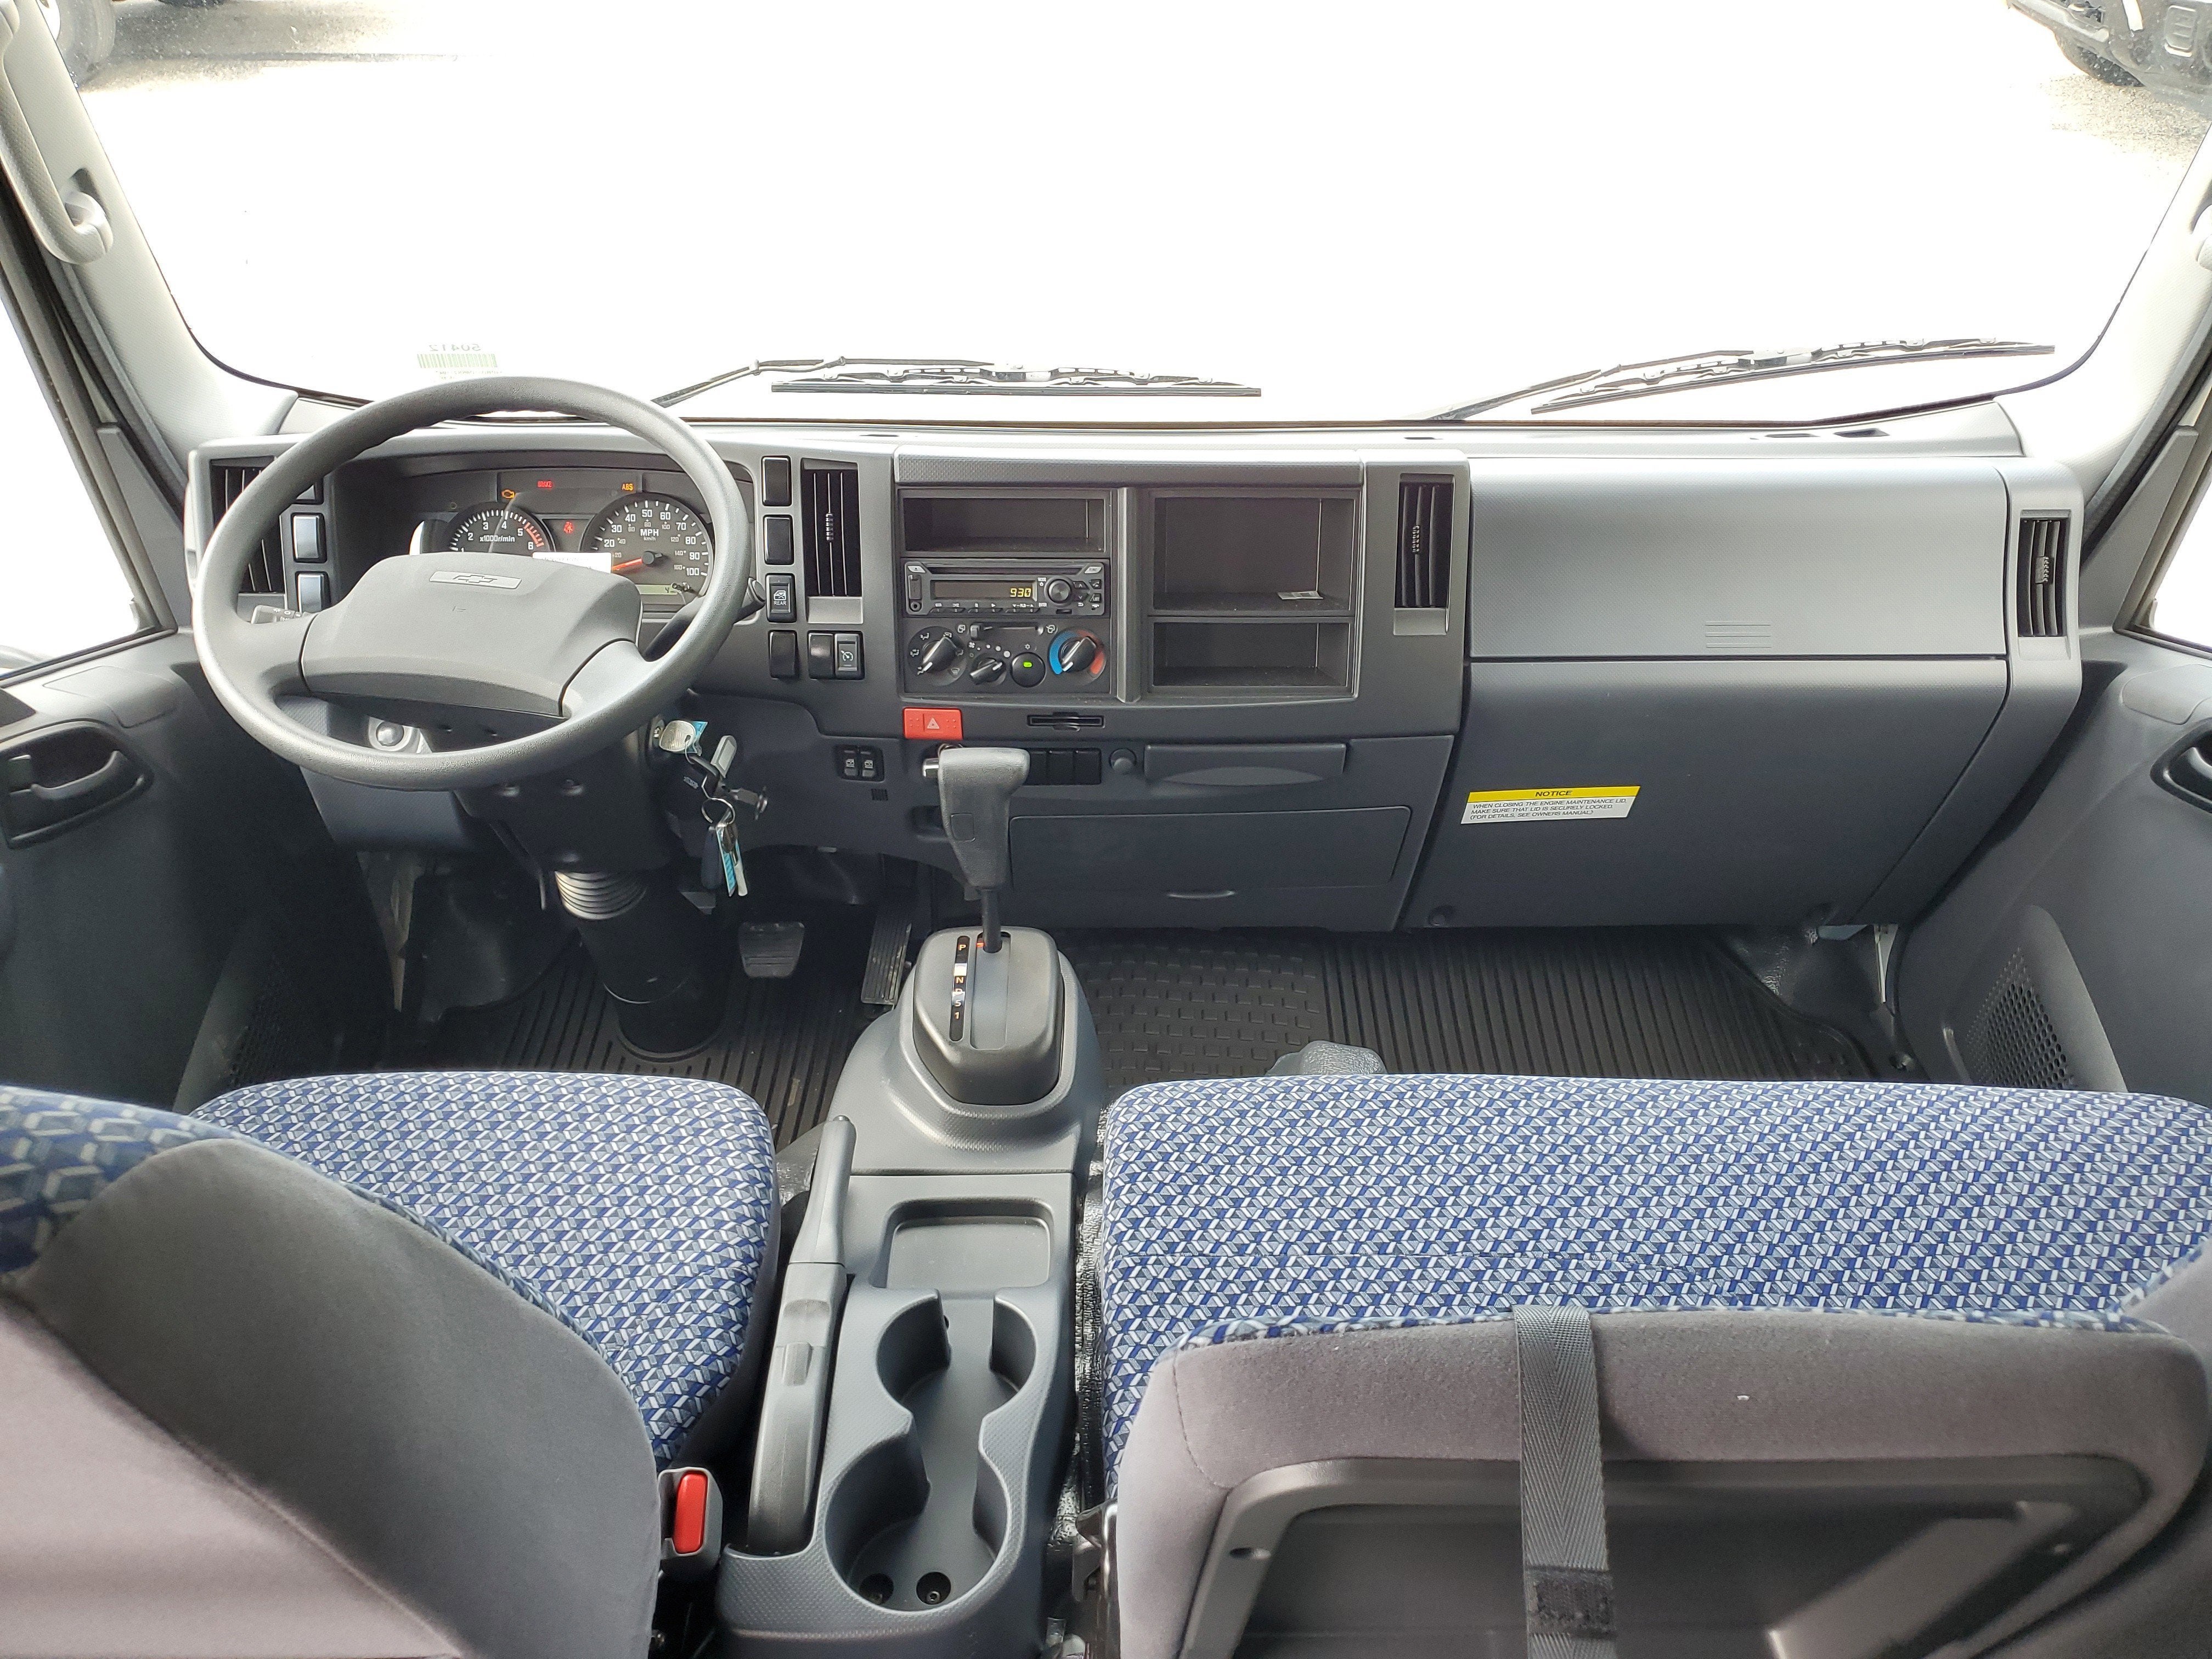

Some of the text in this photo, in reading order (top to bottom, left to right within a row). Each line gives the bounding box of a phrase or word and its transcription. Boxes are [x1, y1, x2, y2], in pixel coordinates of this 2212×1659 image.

[641, 509, 652, 517] 50
[660, 512, 671, 520] 60
[625, 514, 636, 522] 40
[483, 522, 488, 530] 3
[501, 521, 506, 529] 4
[611, 524, 622, 533] 30
[676, 522, 686, 531] 70
[467, 532, 473, 540] 2
[517, 528, 523, 537] 5
[640, 528, 659, 537] MPH
[604, 539, 615, 548] 20
[685, 537, 696, 545] 80
[528, 541, 534, 550] 6
[689, 552, 700, 560] 90
[686, 567, 699, 576] 100
[1010, 588, 1031, 597] 930
